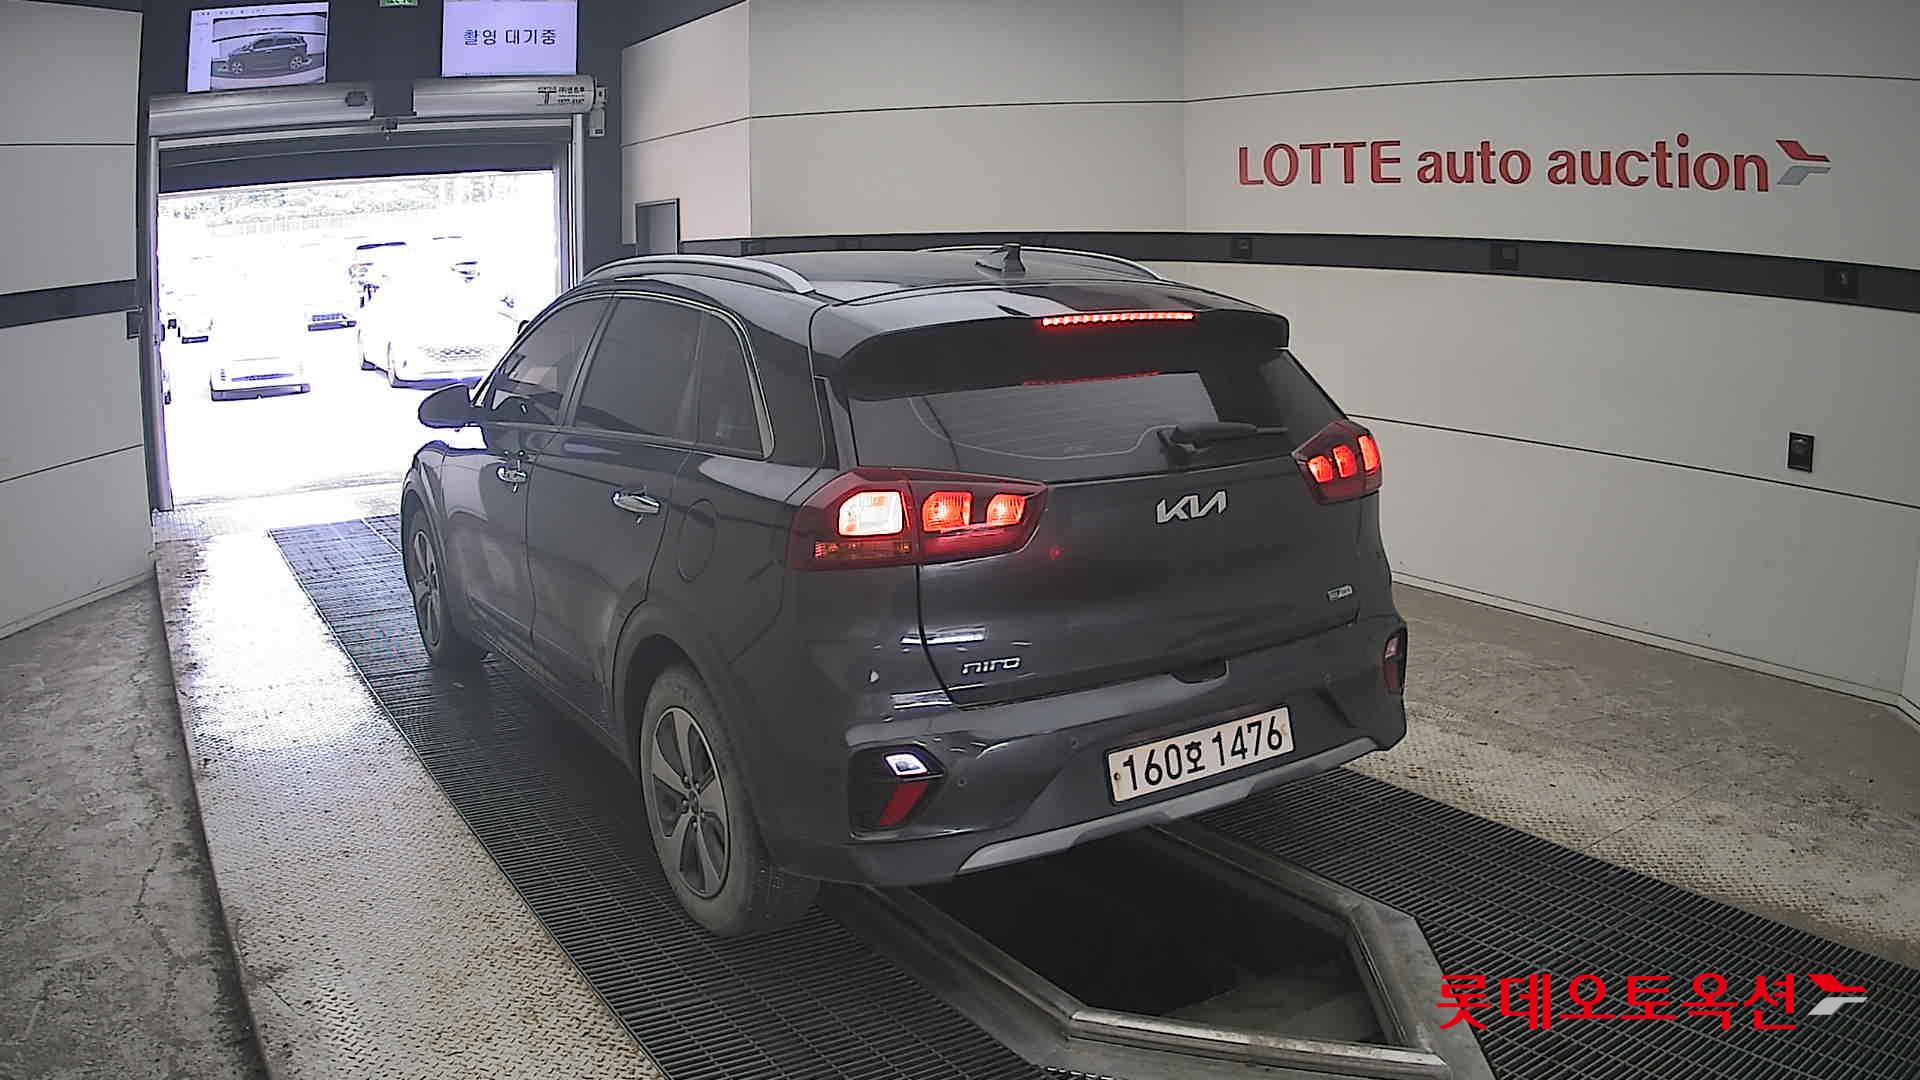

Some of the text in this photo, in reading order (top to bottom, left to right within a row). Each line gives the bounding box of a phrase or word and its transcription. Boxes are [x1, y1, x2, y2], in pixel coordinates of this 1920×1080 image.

[464, 28, 556, 46] 촬영 대기중
[1238, 132, 1770, 193] LOTTE auto auction
[1122, 715, 1283, 791] 160호 1476
